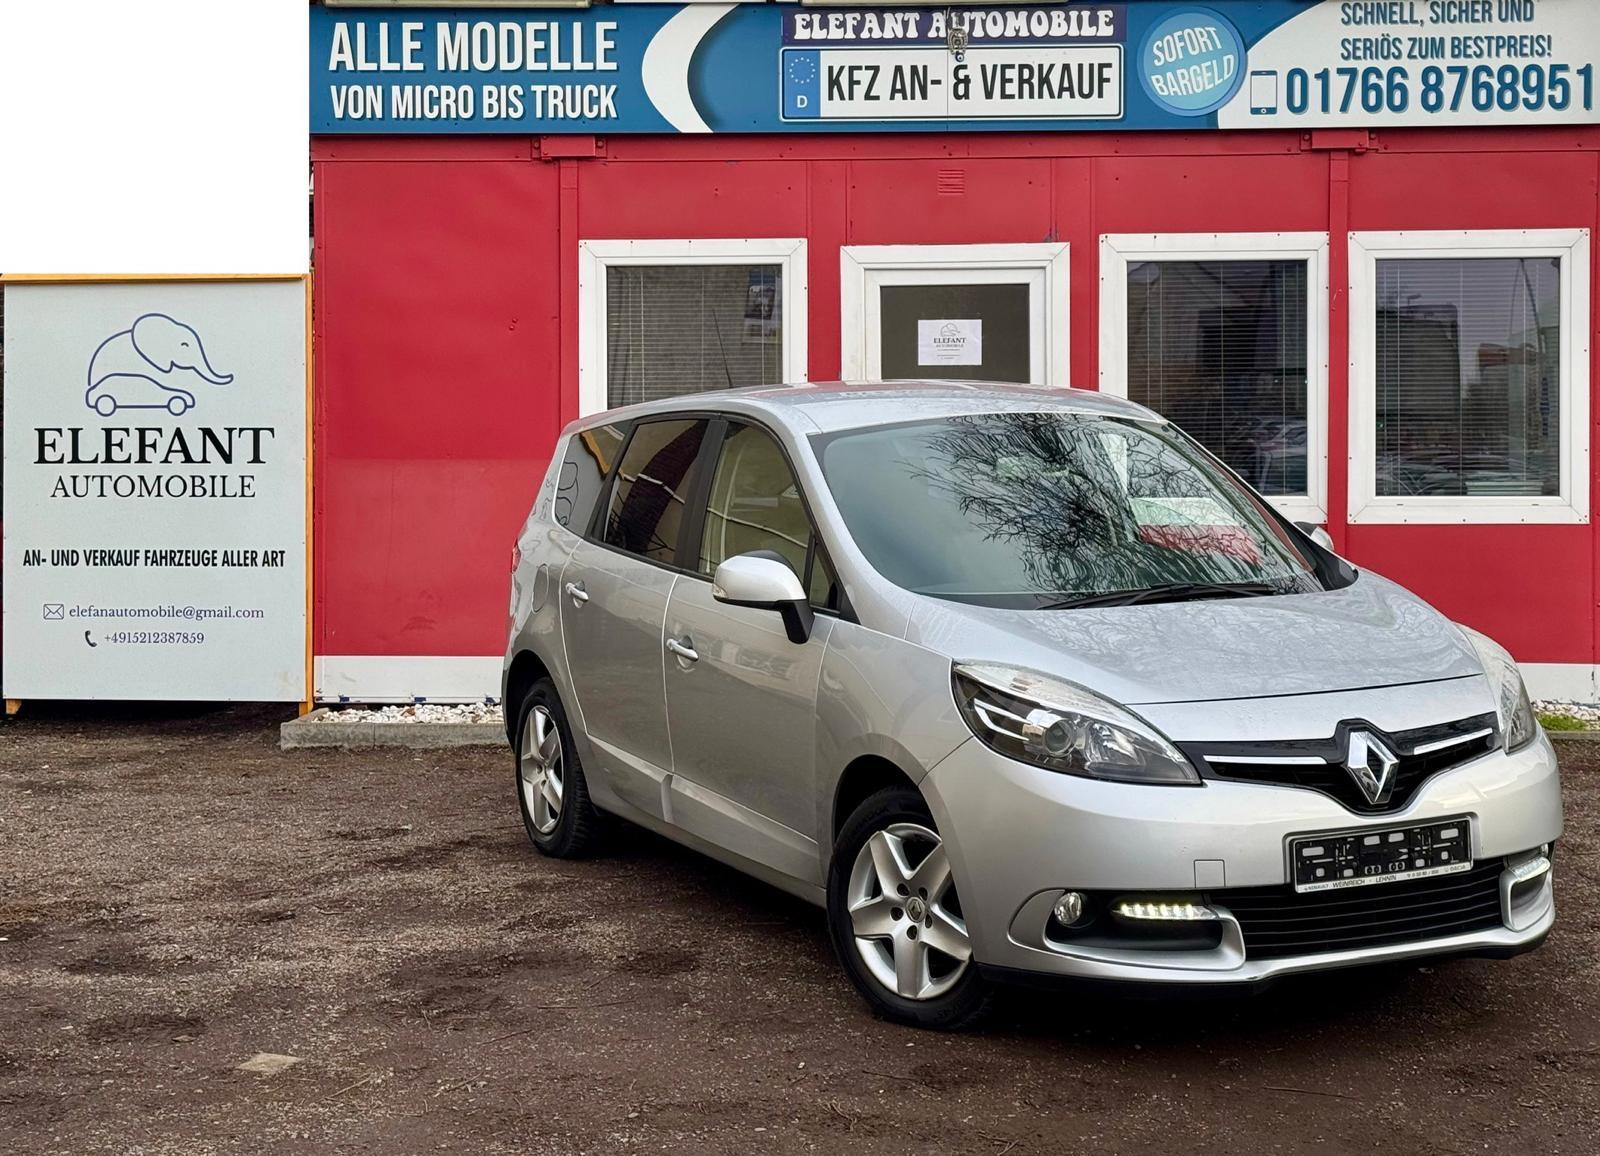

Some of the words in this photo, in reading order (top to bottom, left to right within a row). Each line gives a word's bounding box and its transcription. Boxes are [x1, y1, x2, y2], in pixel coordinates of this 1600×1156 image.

[794, 12, 920, 39] ELEFANT
[927, 10, 1114, 38] AUTOMOBILE
[1341, 1, 1424, 27] SCHNELL,
[1429, 0, 1493, 23] SICHER
[1498, 0, 1535, 22] UND
[329, 22, 425, 71] ALLE
[436, 20, 618, 71] MODELLE
[1152, 27, 1222, 66] SOFORT
[1340, 33, 1403, 60] SERIÖS
[1407, 36, 1446, 59] ZUM
[1450, 34, 1553, 59] BESTPREIS!
[827, 65, 881, 101] KFZ
[889, 64, 942, 100] AN-
[953, 63, 971, 100] &
[980, 62, 1113, 100] VERKAUF
[1151, 54, 1235, 96] BARGELD
[1286, 65, 1409, 114] 01766
[1420, 63, 1594, 114] 8768951
[330, 85, 384, 119] VON
[391, 85, 476, 119] MICRO
[483, 85, 526, 119] BIS
[531, 84, 618, 119] TRUCK
[796, 95, 808, 108] D
[33, 427, 275, 464] ELEFANT
[50, 475, 256, 499] AUTOMOBILE
[23, 549, 47, 567] AN-
[51, 549, 79, 567] UND
[83, 549, 141, 567] VERKAUF
[144, 549, 219, 567] FAHRZEUGE
[221, 549, 259, 568] ALLER
[262, 549, 286, 568] ART
[68, 604, 264, 621] elefanautomobile@gmail.com
[104, 631, 205, 645] +4915212387859
